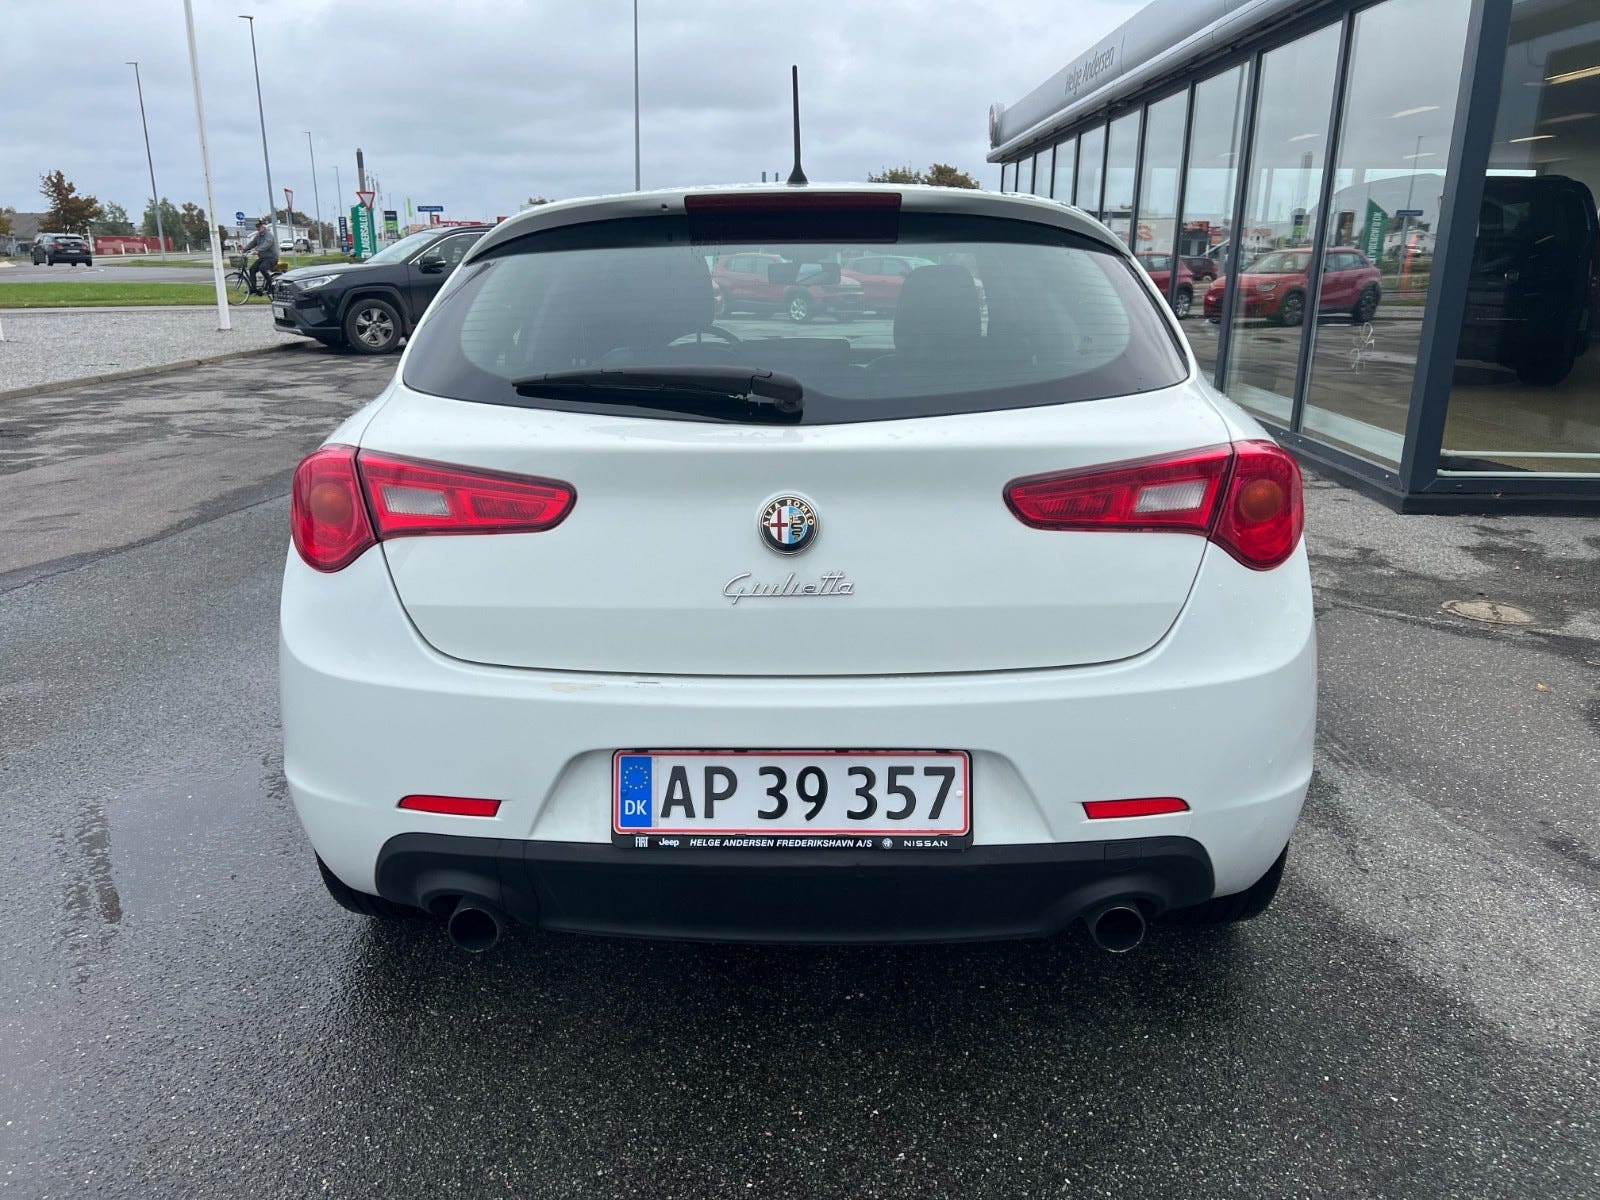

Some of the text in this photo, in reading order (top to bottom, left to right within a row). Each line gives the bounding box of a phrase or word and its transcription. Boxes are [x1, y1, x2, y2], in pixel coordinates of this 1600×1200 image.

[1064, 46, 1115, 96] Helge Andersen
[763, 499, 814, 527] ALFA ROMEO
[723, 571, 855, 604] Giulietta
[660, 765, 956, 821] AP 39 357
[625, 799, 648, 816] DK
[635, 836, 649, 848] FIAT
[659, 837, 680, 848] Jeep
[690, 838, 873, 848] HELGE ANDERSEN FREDERIKSHAVN A/S
